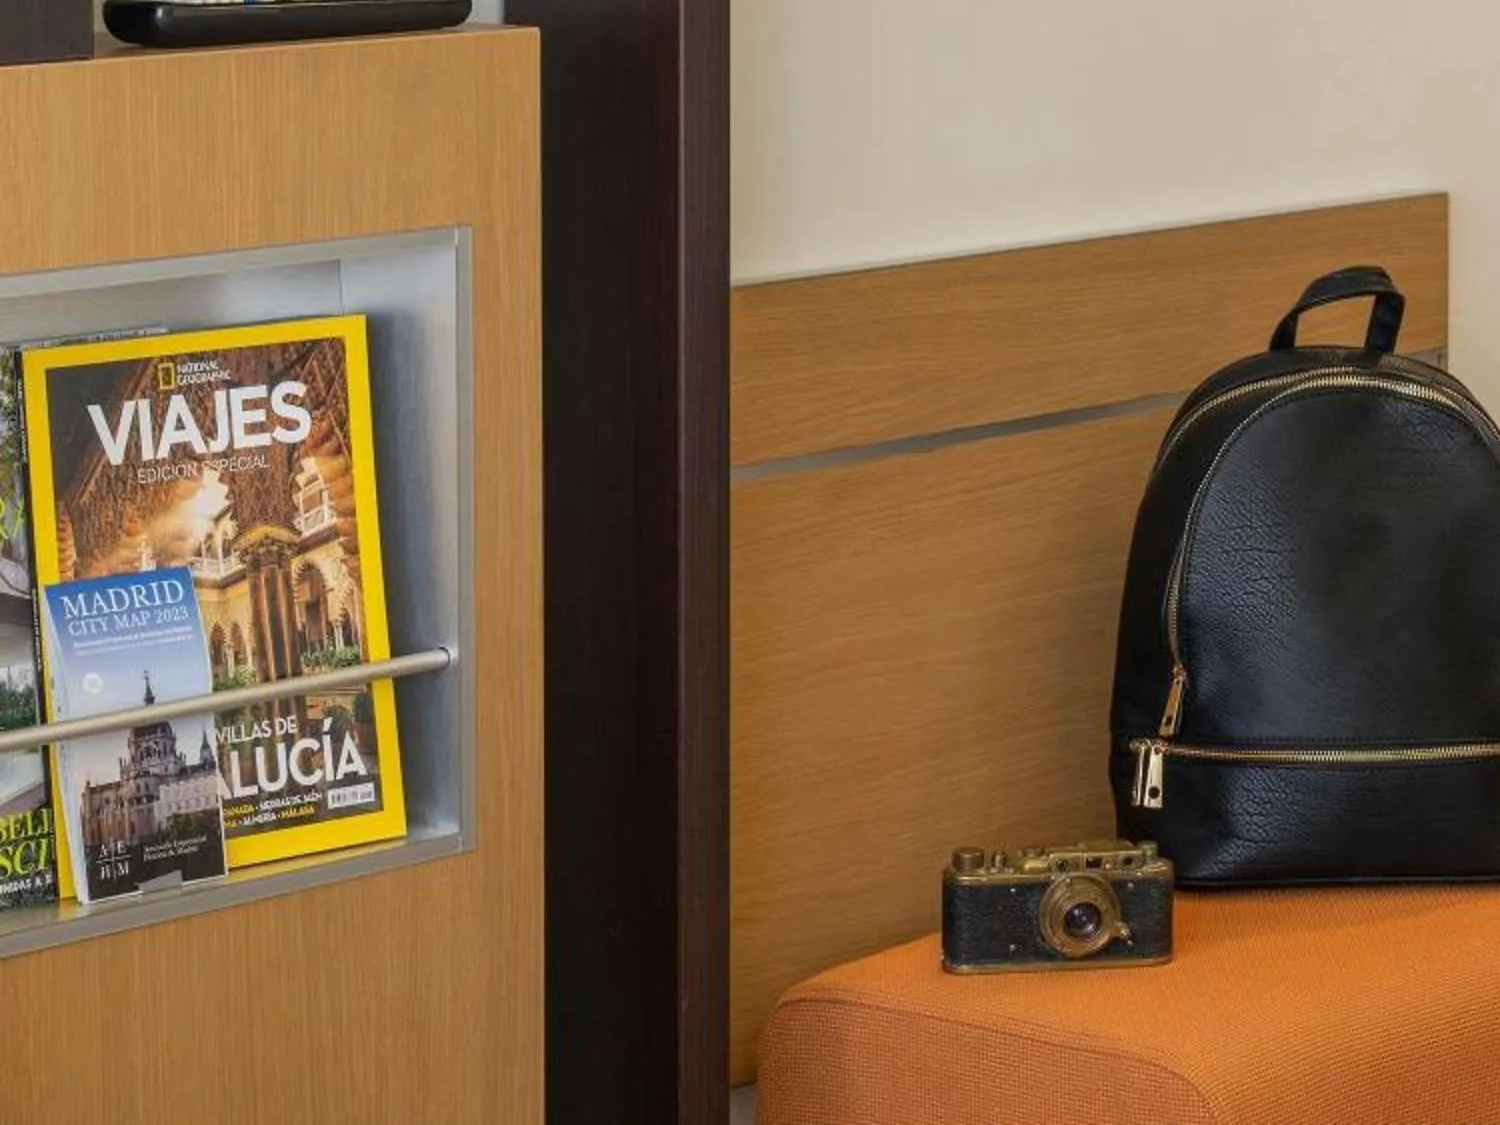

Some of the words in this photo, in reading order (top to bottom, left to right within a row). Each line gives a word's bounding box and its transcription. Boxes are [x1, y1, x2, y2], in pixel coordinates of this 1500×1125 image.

[87, 380, 313, 466] VIAJES
[60, 579, 185, 620] MADRID
[68, 617, 110, 636] CITY
[113, 610, 150, 631] MAP
[153, 606, 189, 624] 2023
[275, 714, 297, 736] DE
